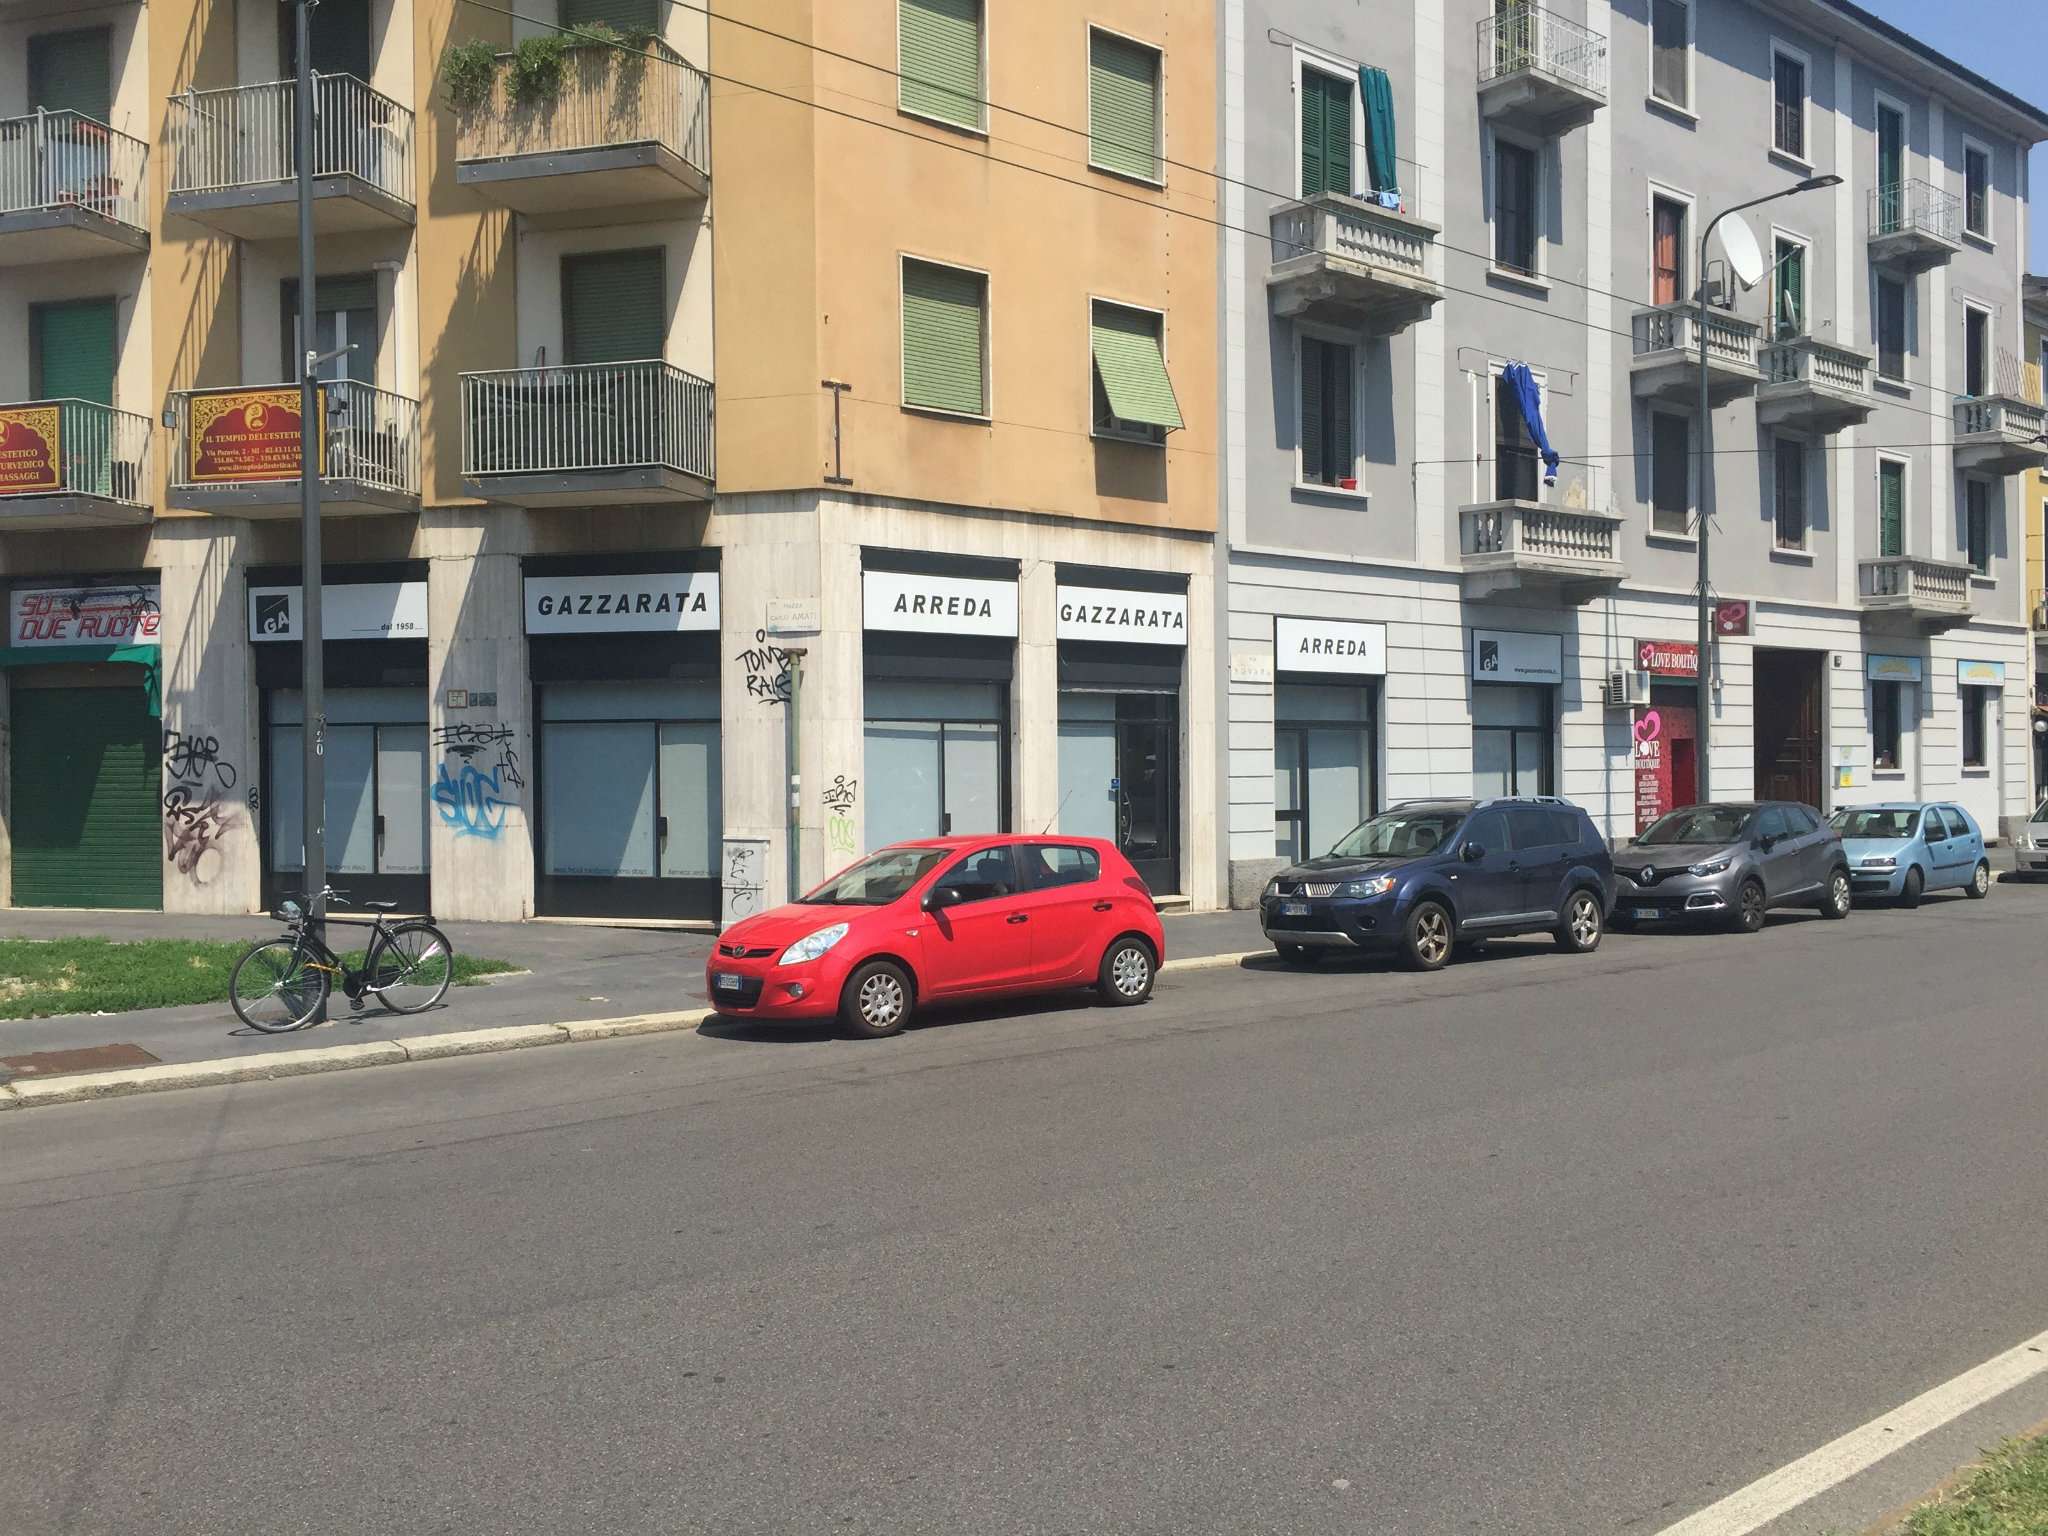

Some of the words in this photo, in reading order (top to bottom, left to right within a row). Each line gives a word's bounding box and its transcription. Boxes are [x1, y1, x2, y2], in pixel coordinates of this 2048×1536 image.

[215, 433, 247, 442] TEMPIO
[248, 432, 301, 440] DELL'ESTETIC
[538, 592, 707, 616] GAZZARATA
[894, 593, 992, 617] ARREDA
[19, 617, 71, 640] DUE
[77, 614, 160, 638] RUOTE
[263, 610, 290, 634] GA
[396, 622, 414, 630] 1958
[1060, 603, 1184, 629] GAZZARATA
[1299, 637, 1367, 657] ARREDA
[1483, 654, 1498, 672] GA
[1651, 652, 1671, 667] LOVE
[1671, 650, 1698, 671] BOUTIQ
